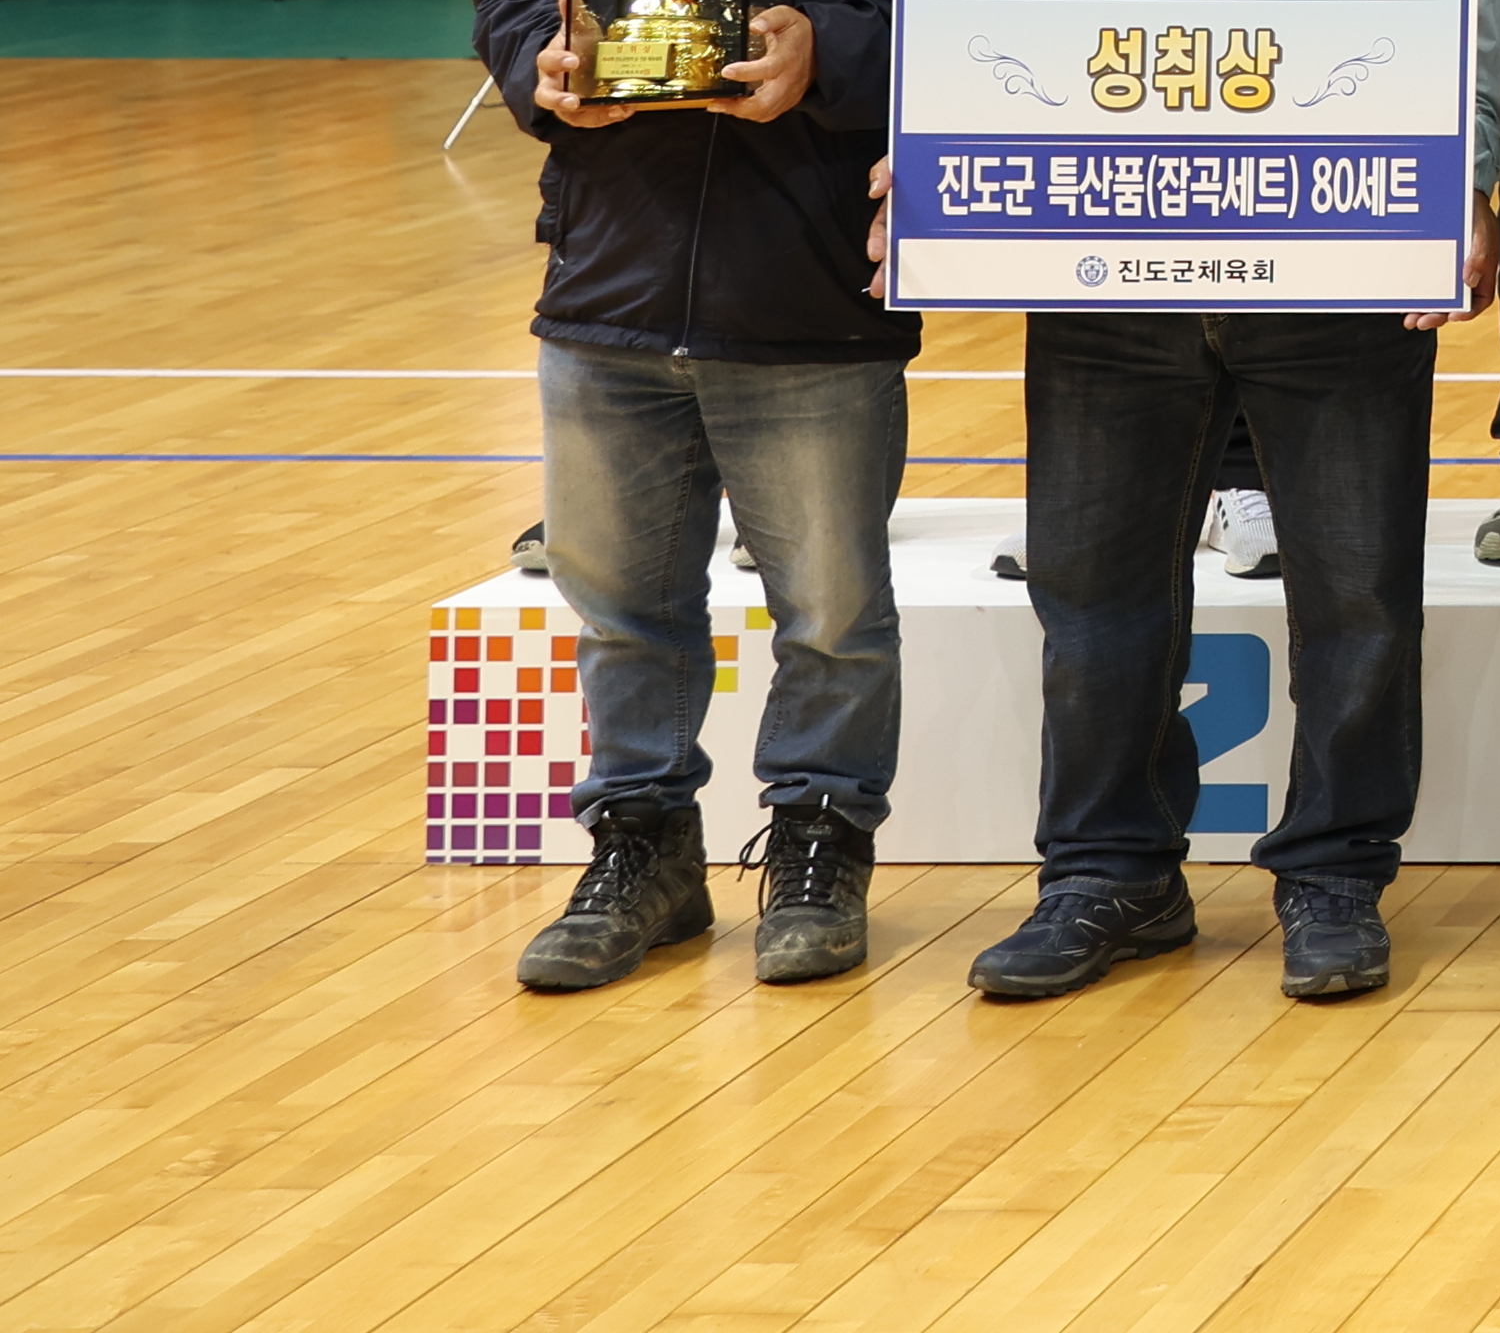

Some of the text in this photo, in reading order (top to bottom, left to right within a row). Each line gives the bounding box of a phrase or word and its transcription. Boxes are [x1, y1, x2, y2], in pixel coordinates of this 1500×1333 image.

[1087, 25, 1282, 112] 성취상
[937, 156, 1420, 218] 진도군 특산품(잡곡세트) 80세트
[1118, 259, 1275, 284] 진도군체육회
